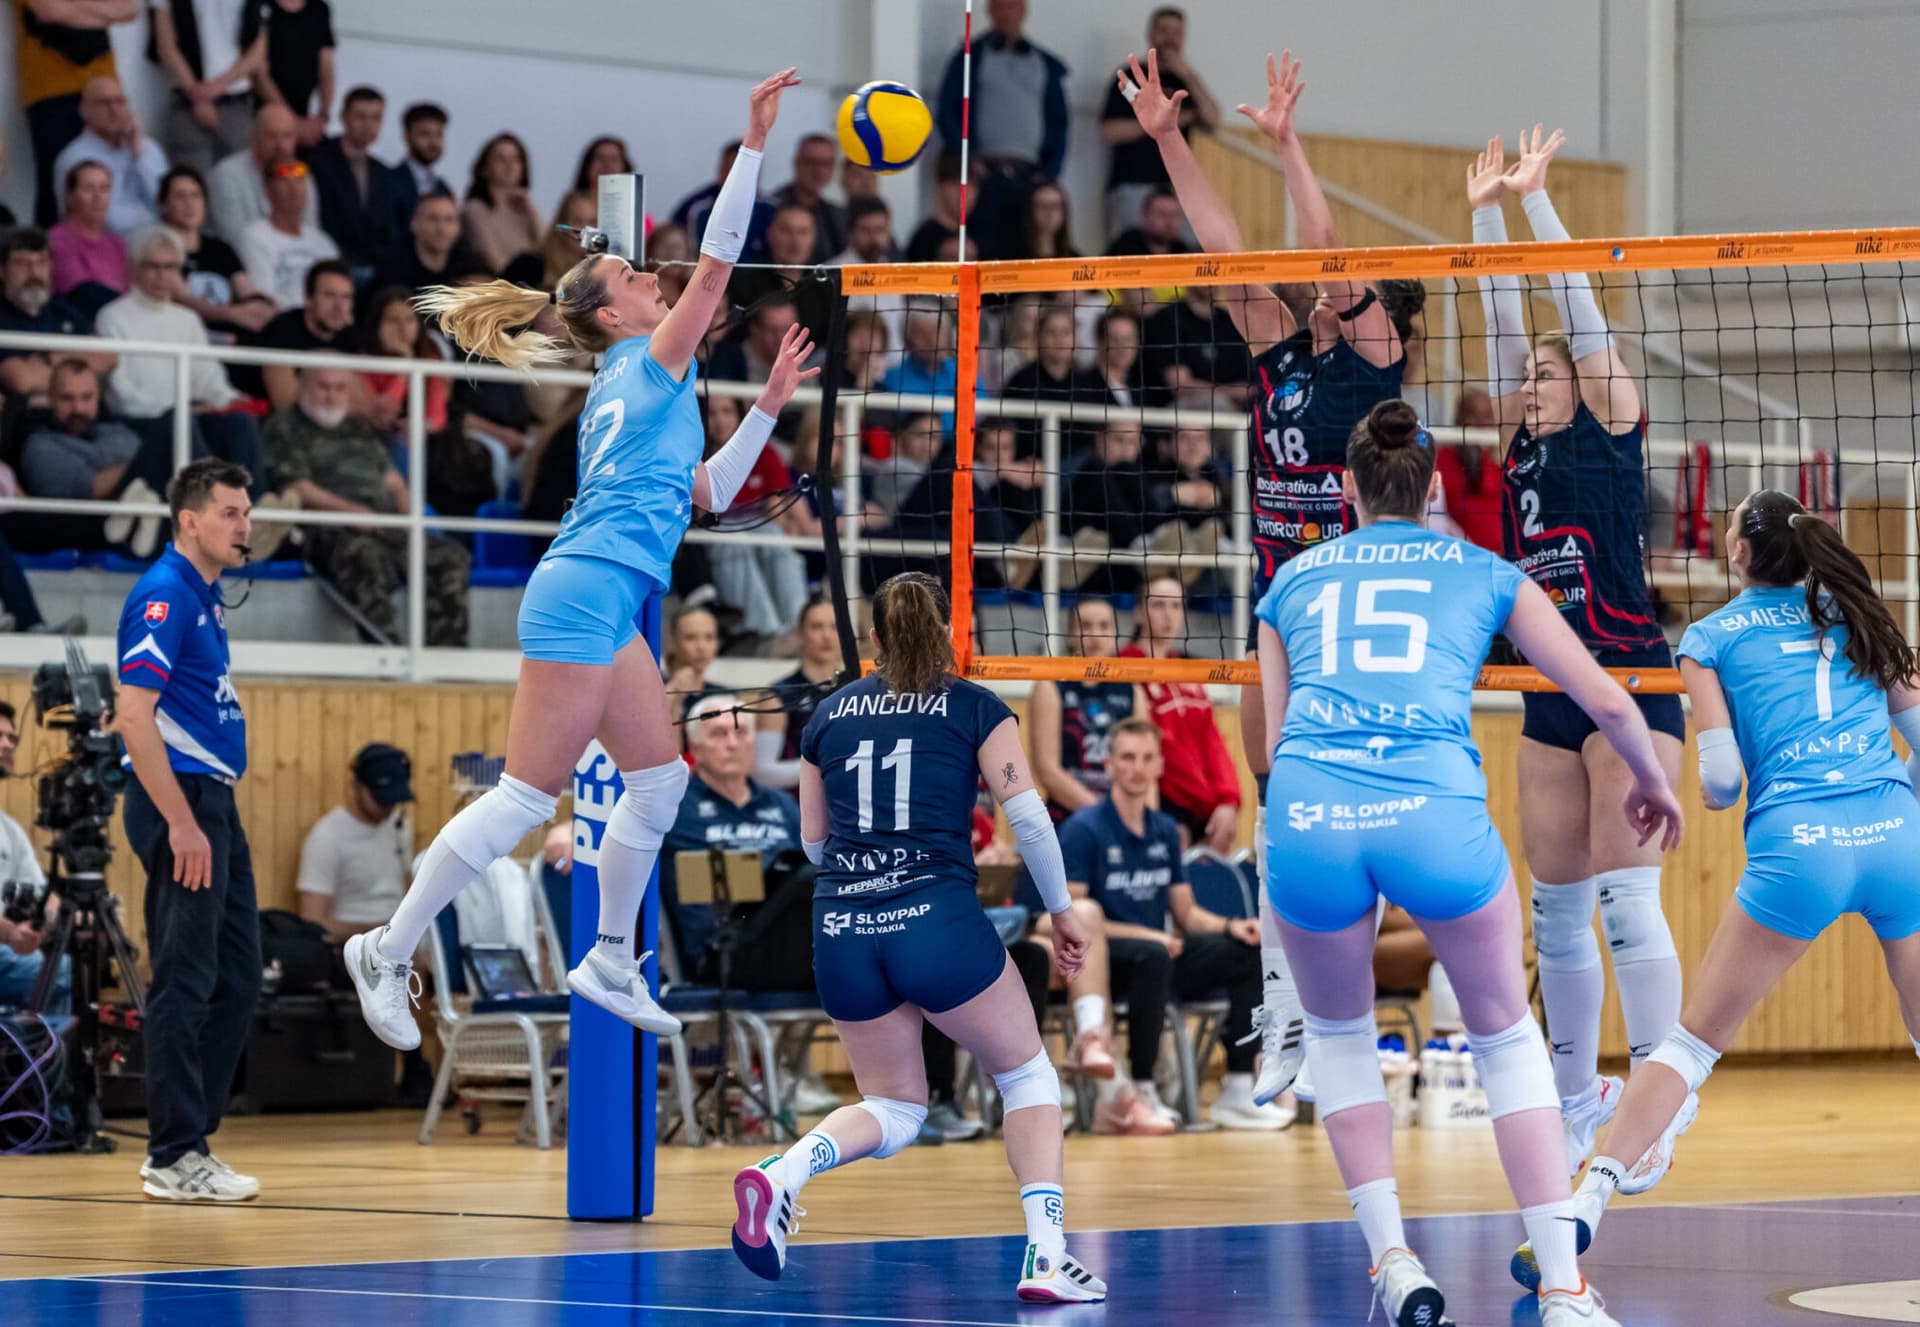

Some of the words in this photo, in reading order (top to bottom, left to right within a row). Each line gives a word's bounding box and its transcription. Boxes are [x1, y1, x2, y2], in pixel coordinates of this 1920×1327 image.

[1264, 427, 1309, 467] 18
[1520, 489, 1544, 538] 2
[1306, 578, 1433, 677] 15
[1780, 637, 1837, 722] 7
[844, 738, 913, 834] 11
[1330, 795, 1428, 819] SLOVPAP
[1831, 817, 1905, 838] SLOVPAP
[854, 922, 907, 935] SLOVAKIA
[855, 903, 932, 925] SLOVPAP
